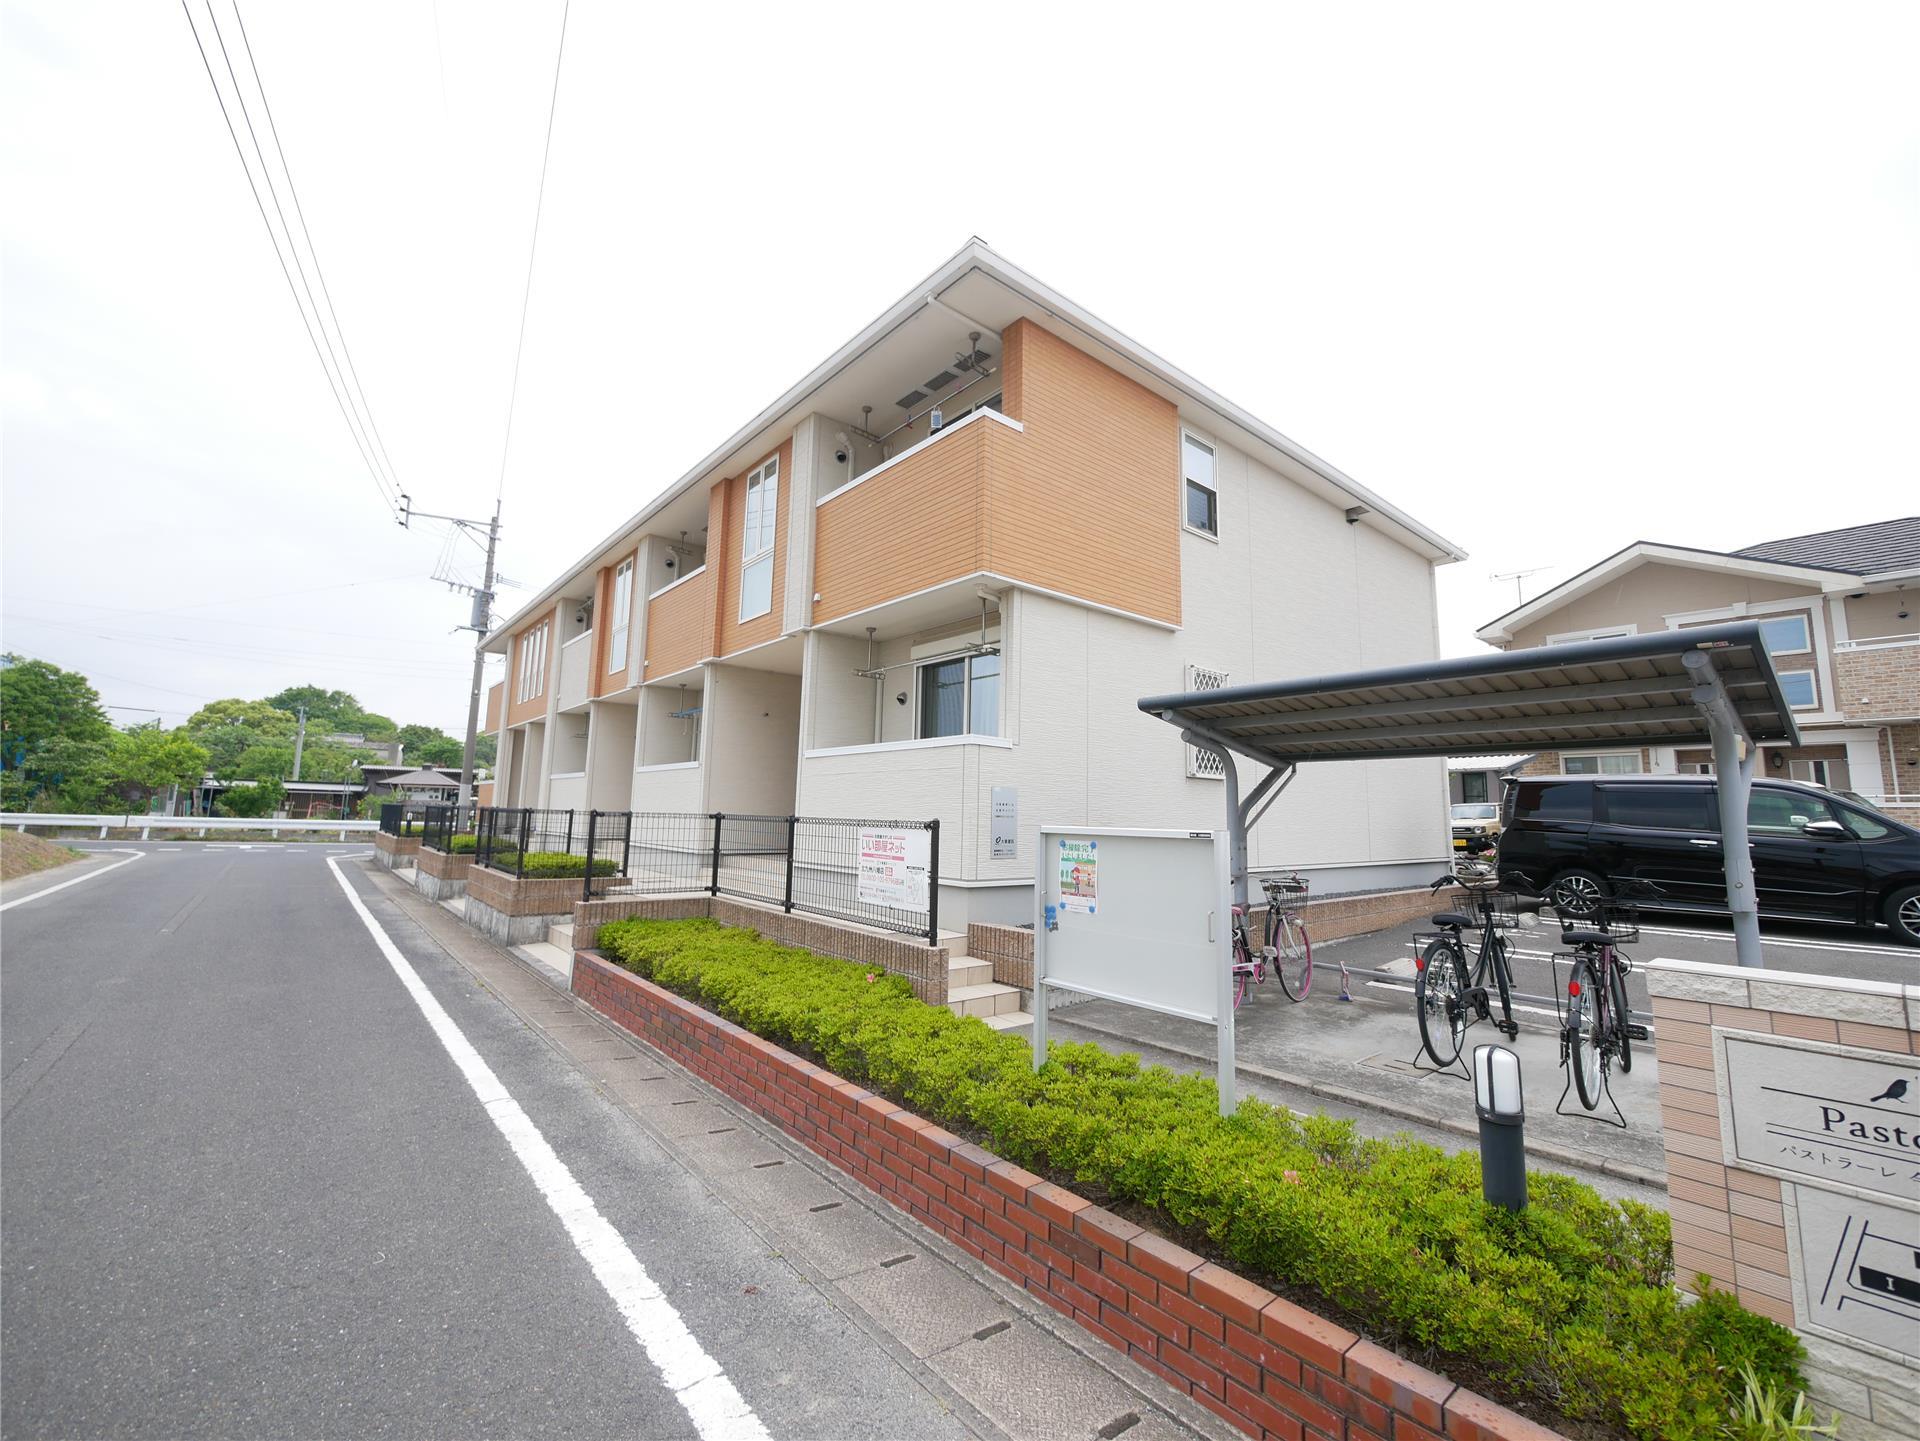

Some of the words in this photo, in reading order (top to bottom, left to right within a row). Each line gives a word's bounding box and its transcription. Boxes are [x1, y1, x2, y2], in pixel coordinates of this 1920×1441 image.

[862, 839, 905, 854] いい部屋ネット
